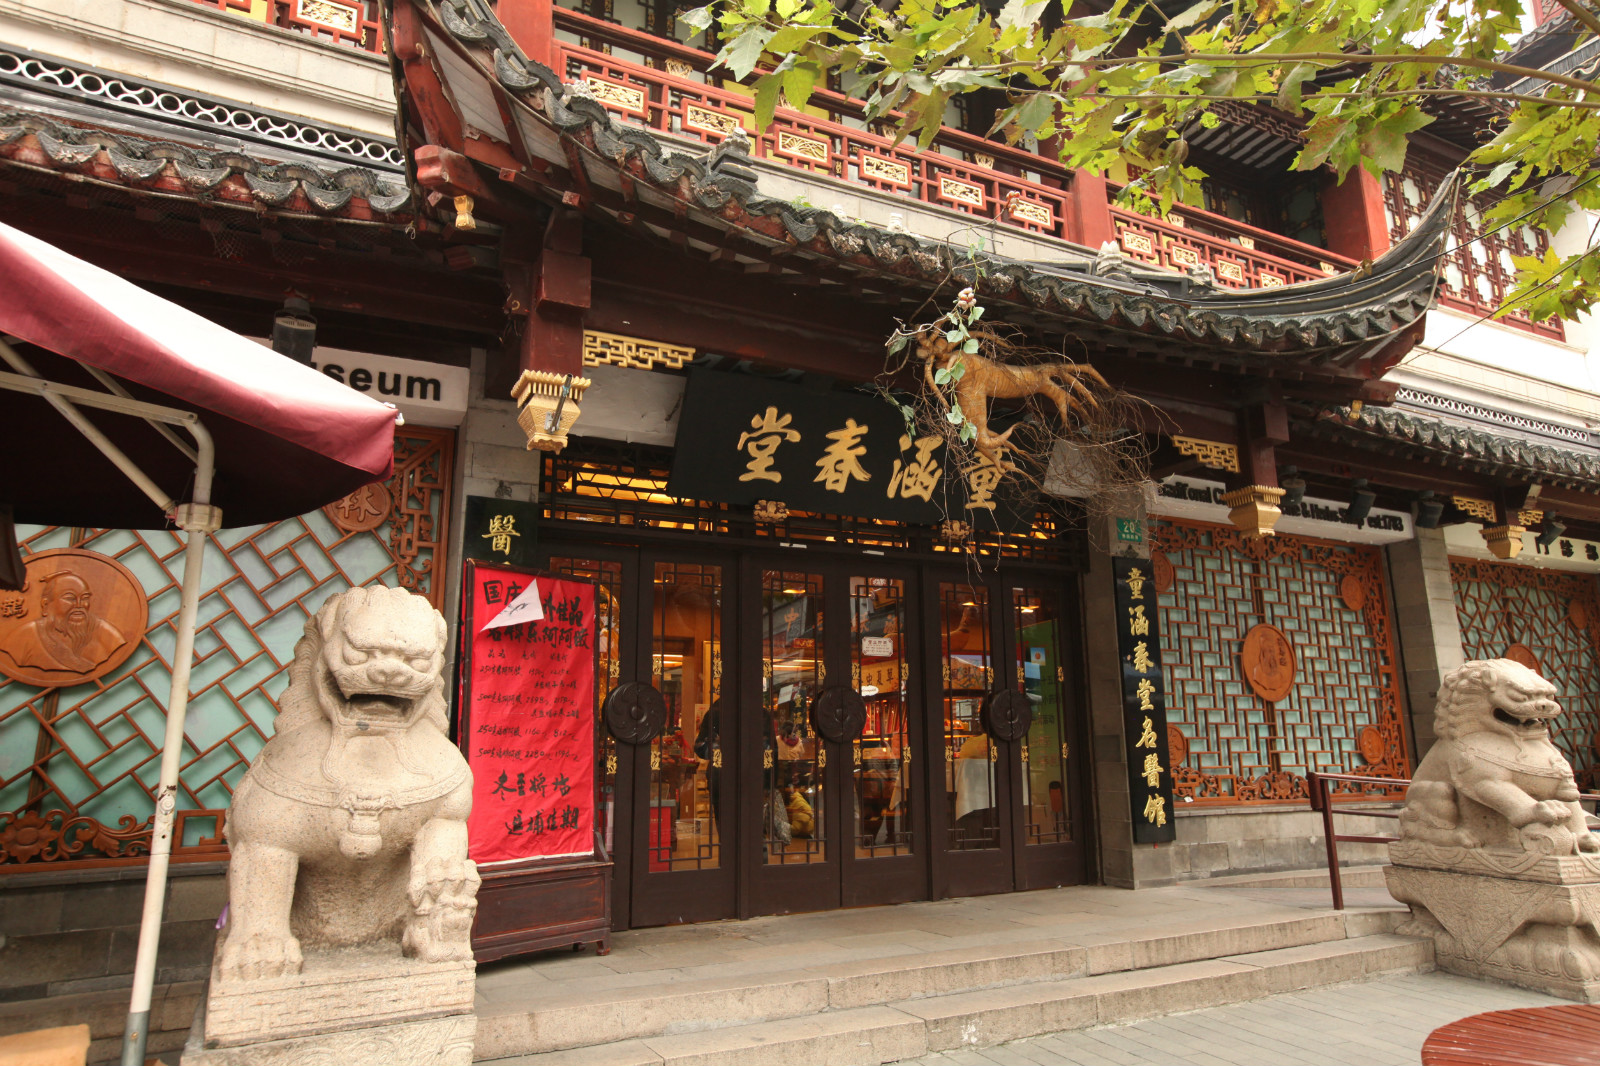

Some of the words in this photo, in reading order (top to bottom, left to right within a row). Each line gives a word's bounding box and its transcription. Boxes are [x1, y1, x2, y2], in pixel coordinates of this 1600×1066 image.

[311, 362, 441, 401] seum
[481, 514, 521, 565] 醫
[861, 667, 894, 687] 虫夏草
